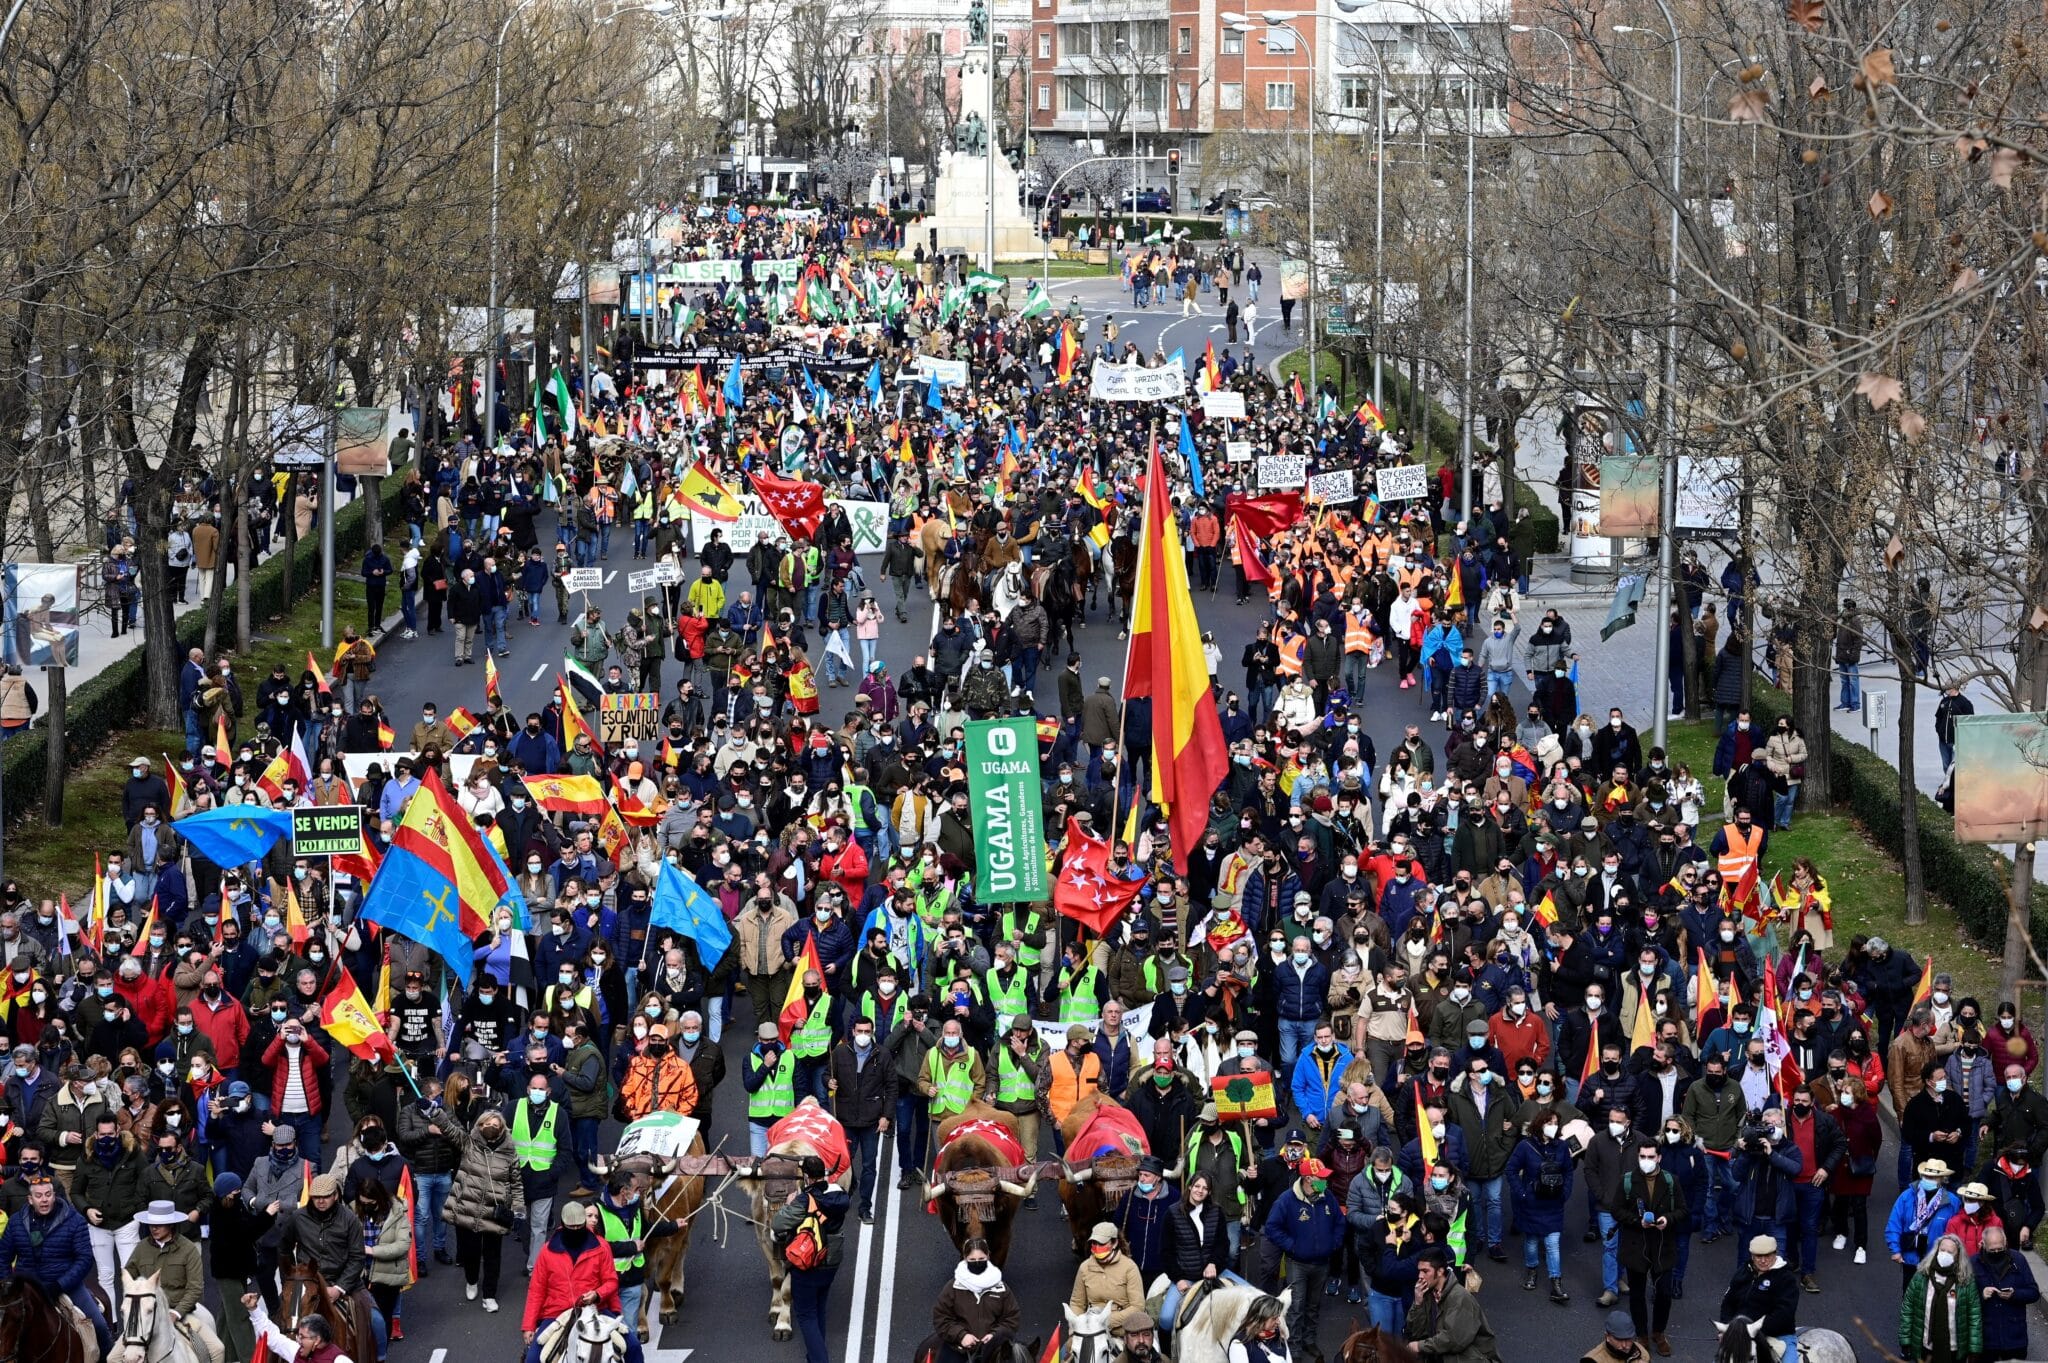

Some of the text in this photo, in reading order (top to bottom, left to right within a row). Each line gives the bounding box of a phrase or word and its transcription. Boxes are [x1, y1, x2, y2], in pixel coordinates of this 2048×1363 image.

[700, 262, 724, 279] SE
[1266, 456, 1298, 464] CRIAR
[1260, 463, 1288, 472] PERROS
[1380, 465, 1425, 480] SOY CRIADOR
[1260, 476, 1304, 484] CONSERVAR
[1312, 475, 1327, 483] SOY
[1394, 474, 1426, 484] PERROS
[731, 530, 776, 538] POR UA
[602, 709, 658, 725] ESCLAVITUD
[608, 724, 658, 740] Y RUINA
[981, 761, 1031, 775] UGAMA
[296, 815, 358, 832] SE VENDE
[985, 783, 1017, 893] UGAMA
[1029, 836, 1035, 844] de
[297, 838, 358, 851] POLITICO
[1023, 862, 1030, 871] de
